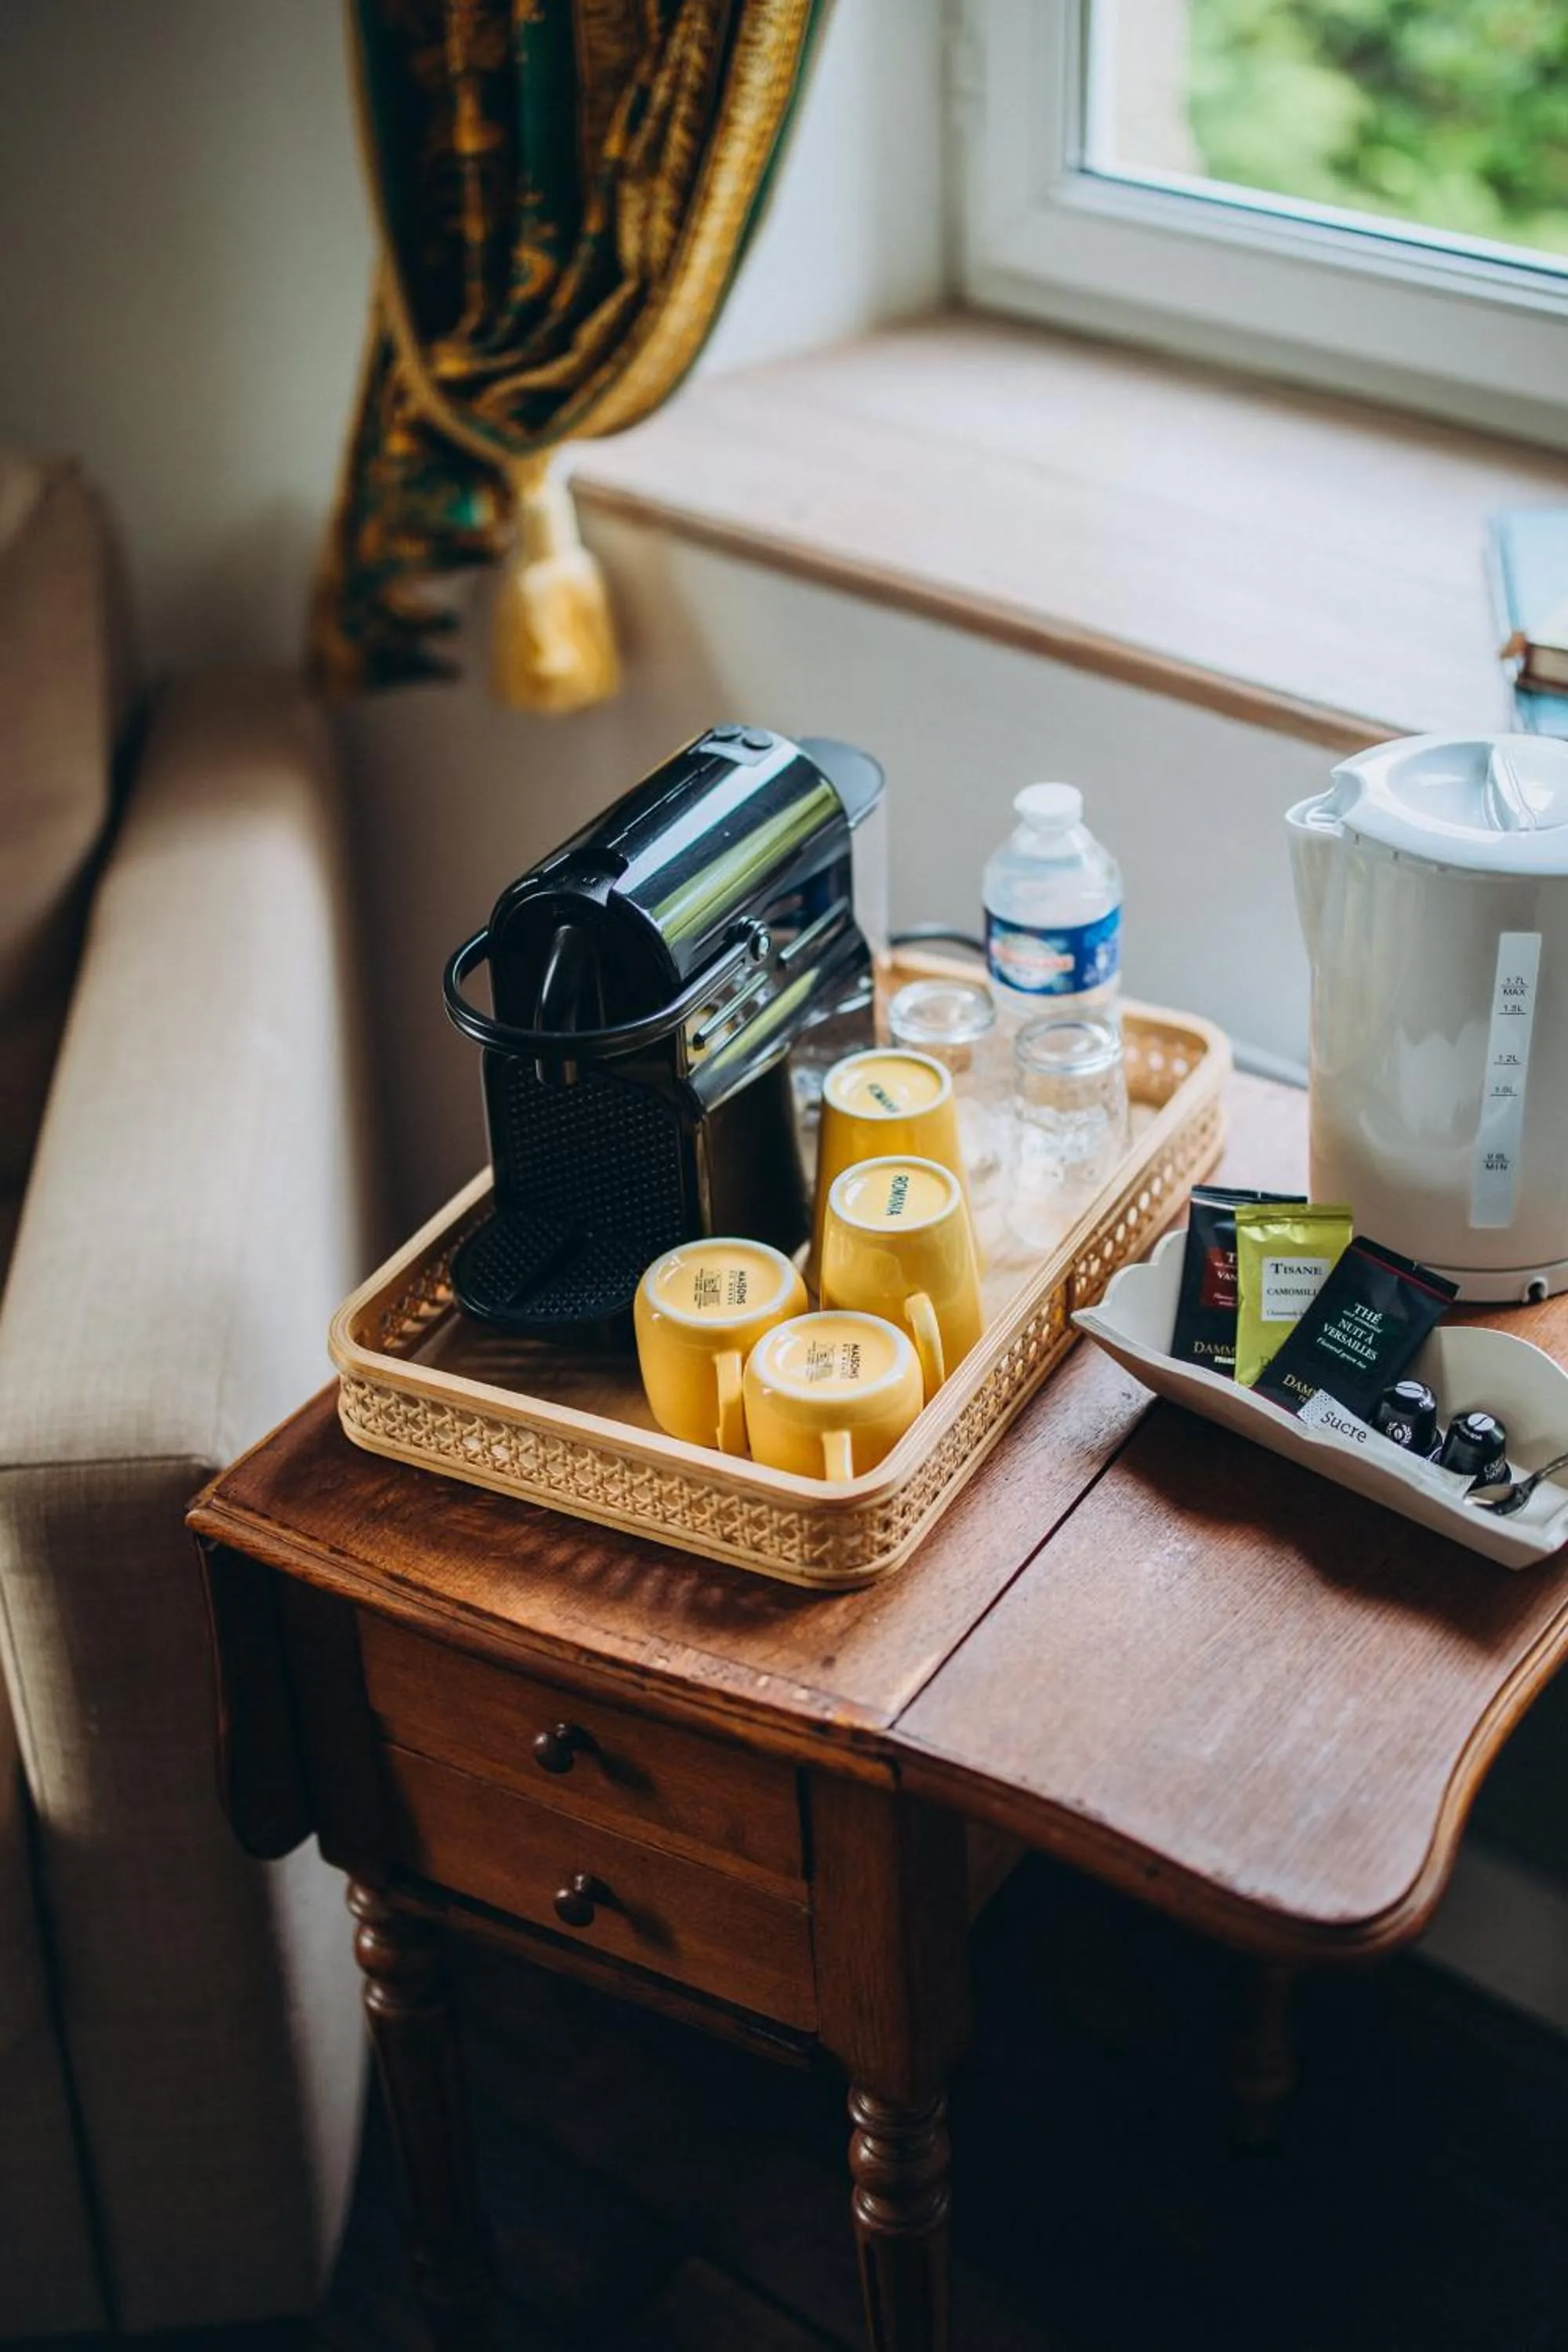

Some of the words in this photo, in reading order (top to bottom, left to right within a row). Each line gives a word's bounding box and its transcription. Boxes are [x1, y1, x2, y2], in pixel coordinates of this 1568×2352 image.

[736, 1270, 747, 1305] MAISONS
[1323, 1323, 1378, 1360] VERSAILLES
[1320, 1410, 1367, 1443] Sucre
